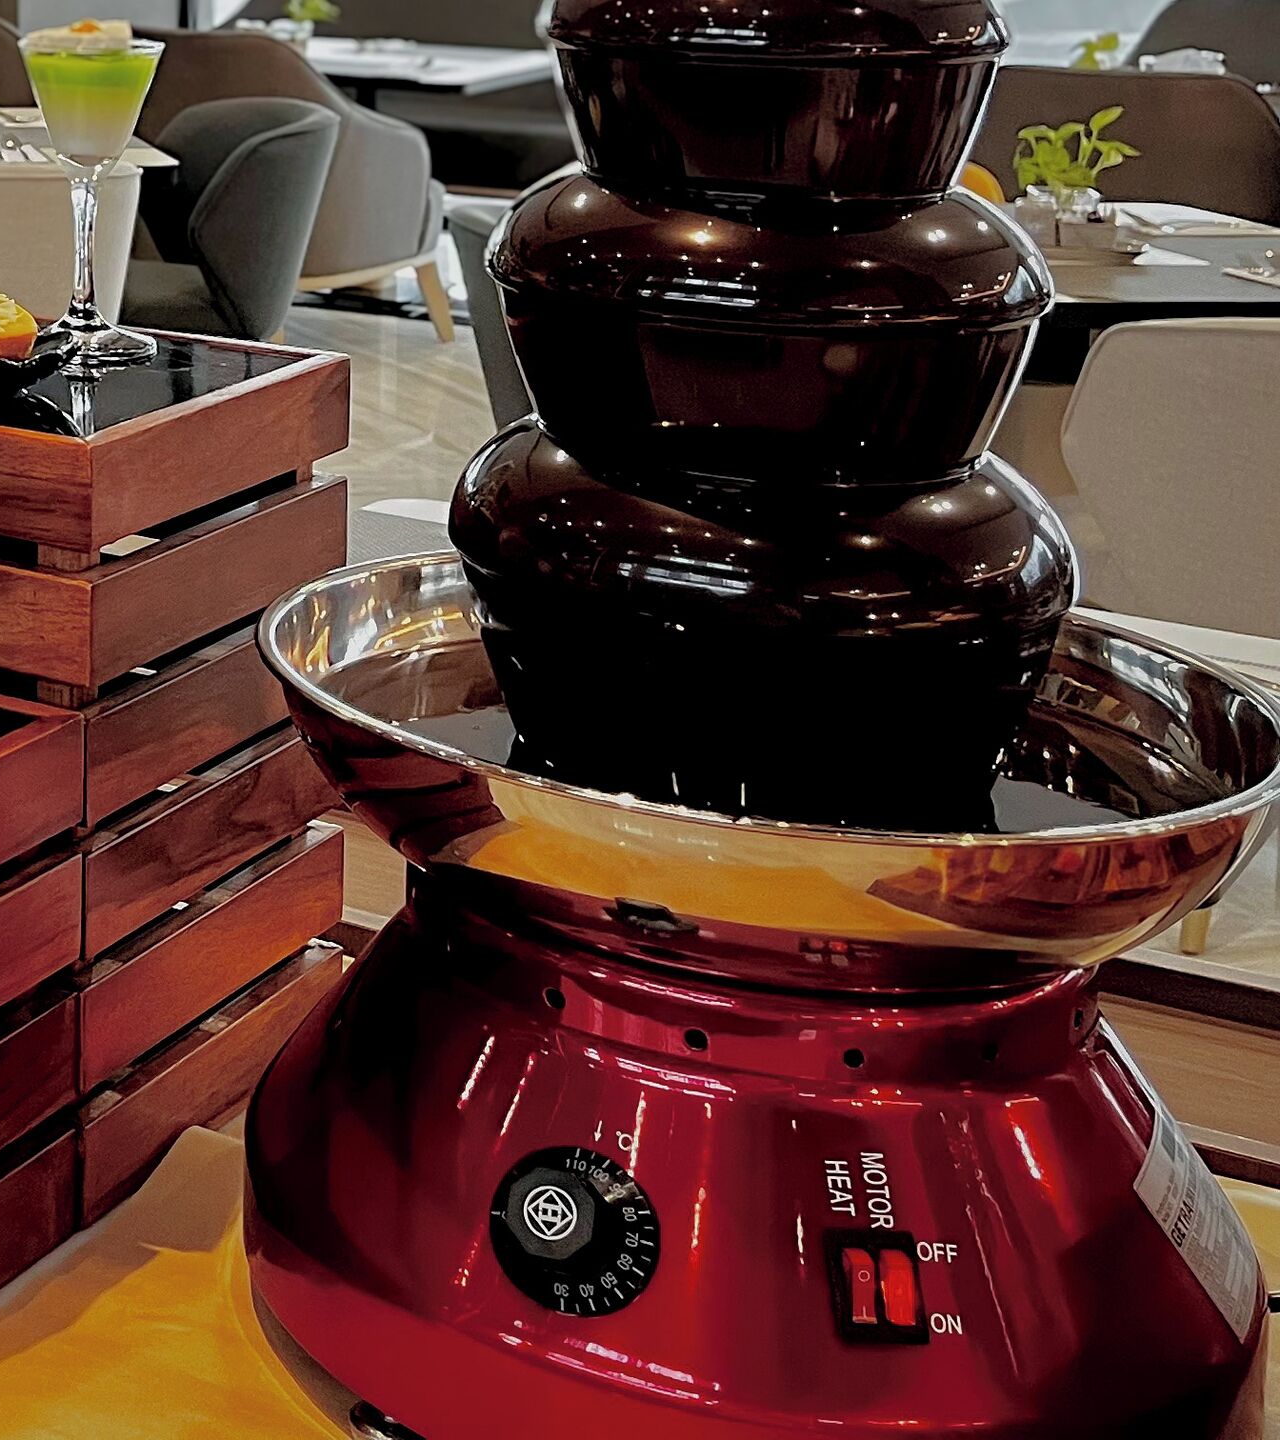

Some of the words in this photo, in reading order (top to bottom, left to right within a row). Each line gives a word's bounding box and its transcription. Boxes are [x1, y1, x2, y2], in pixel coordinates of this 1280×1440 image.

[565, 1158, 587, 1172] 110
[588, 1165, 610, 1182] 100
[609, 1183, 626, 1198] 90
[824, 1160, 856, 1217] HEAT
[860, 1151, 894, 1229] MOTOR
[622, 1206, 638, 1222] 80
[625, 1231, 639, 1248] 70
[916, 1241, 958, 1263] OFF
[617, 1253, 633, 1271] 60
[600, 1271, 618, 1289] 50
[553, 1282, 570, 1297] 30
[579, 1283, 595, 1298] 40
[930, 1313, 963, 1335] ON
